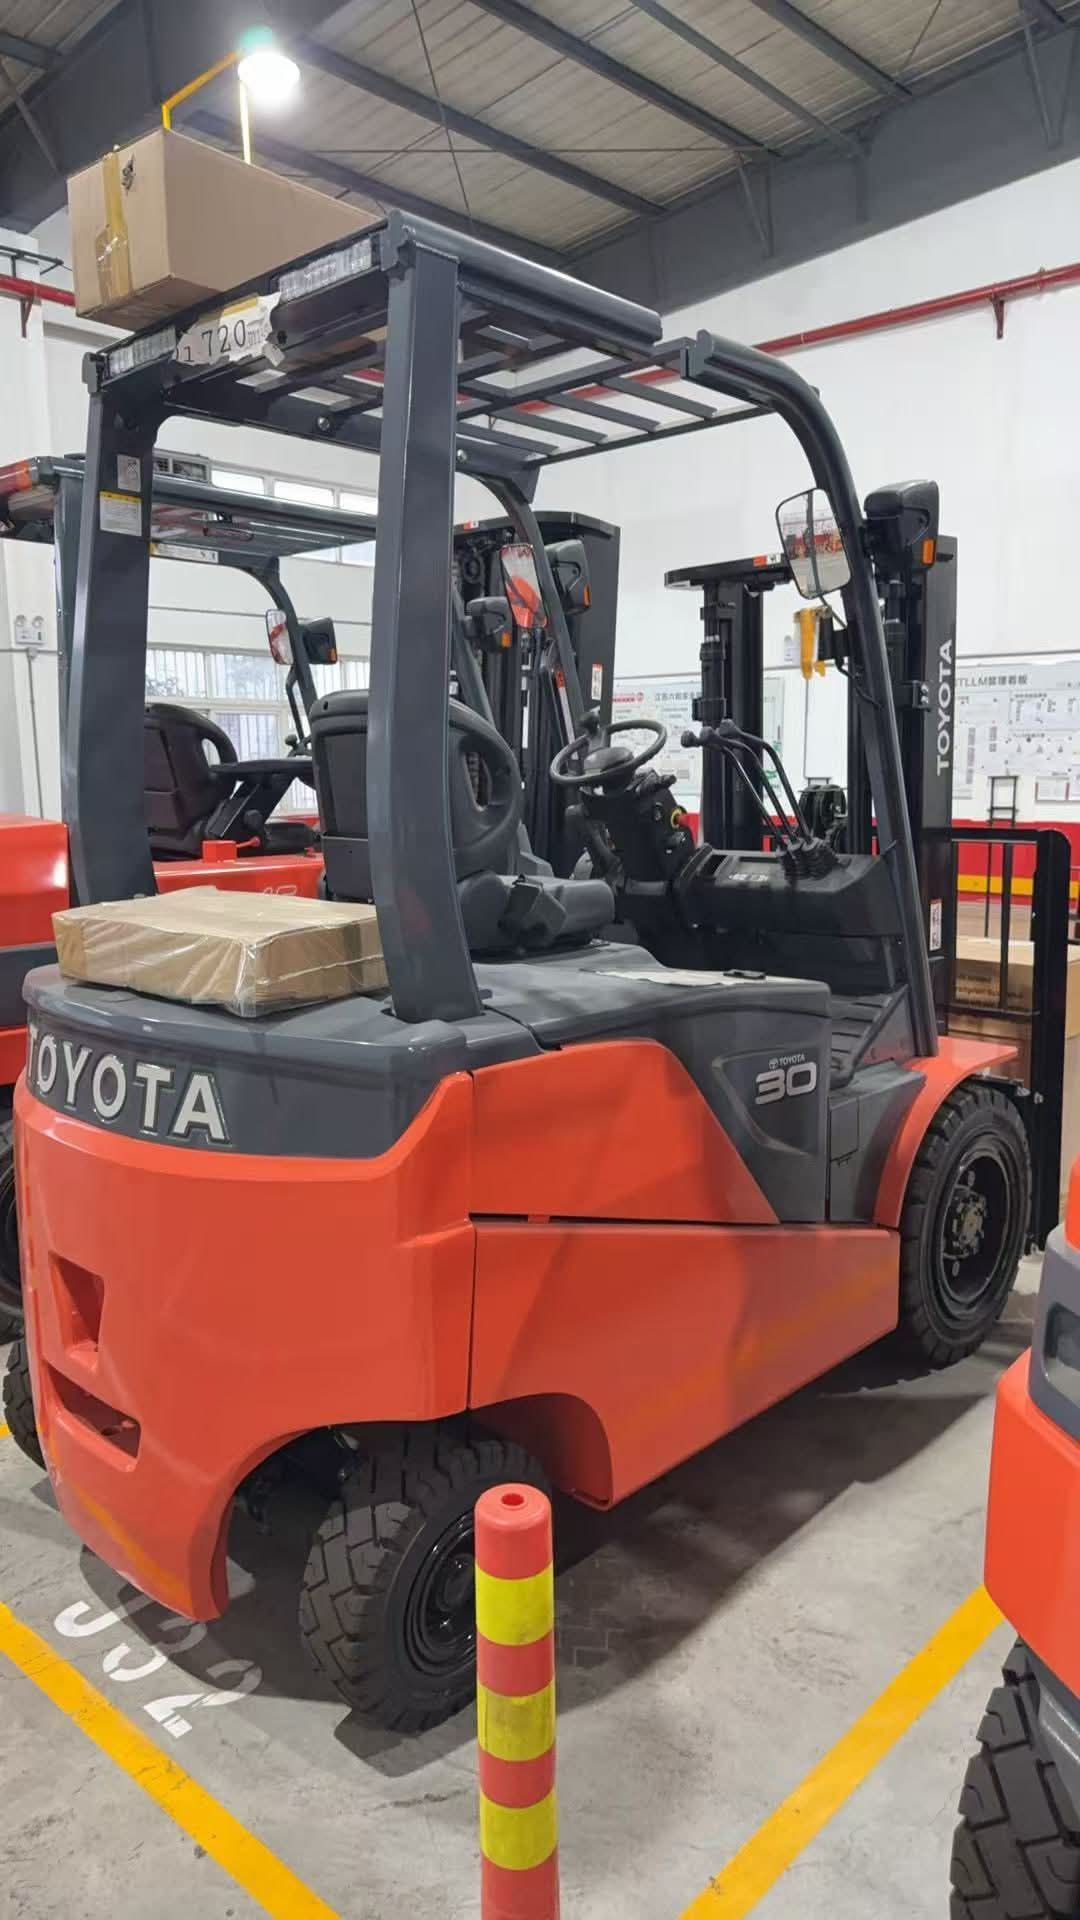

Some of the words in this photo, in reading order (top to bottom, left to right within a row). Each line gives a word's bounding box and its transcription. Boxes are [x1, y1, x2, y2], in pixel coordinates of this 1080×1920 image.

[936, 639, 952, 777] TOYOTA
[27, 1024, 228, 1141] TOYOTA
[755, 1061, 817, 1105] 30
[779, 1053, 806, 1066] TOYOTA
